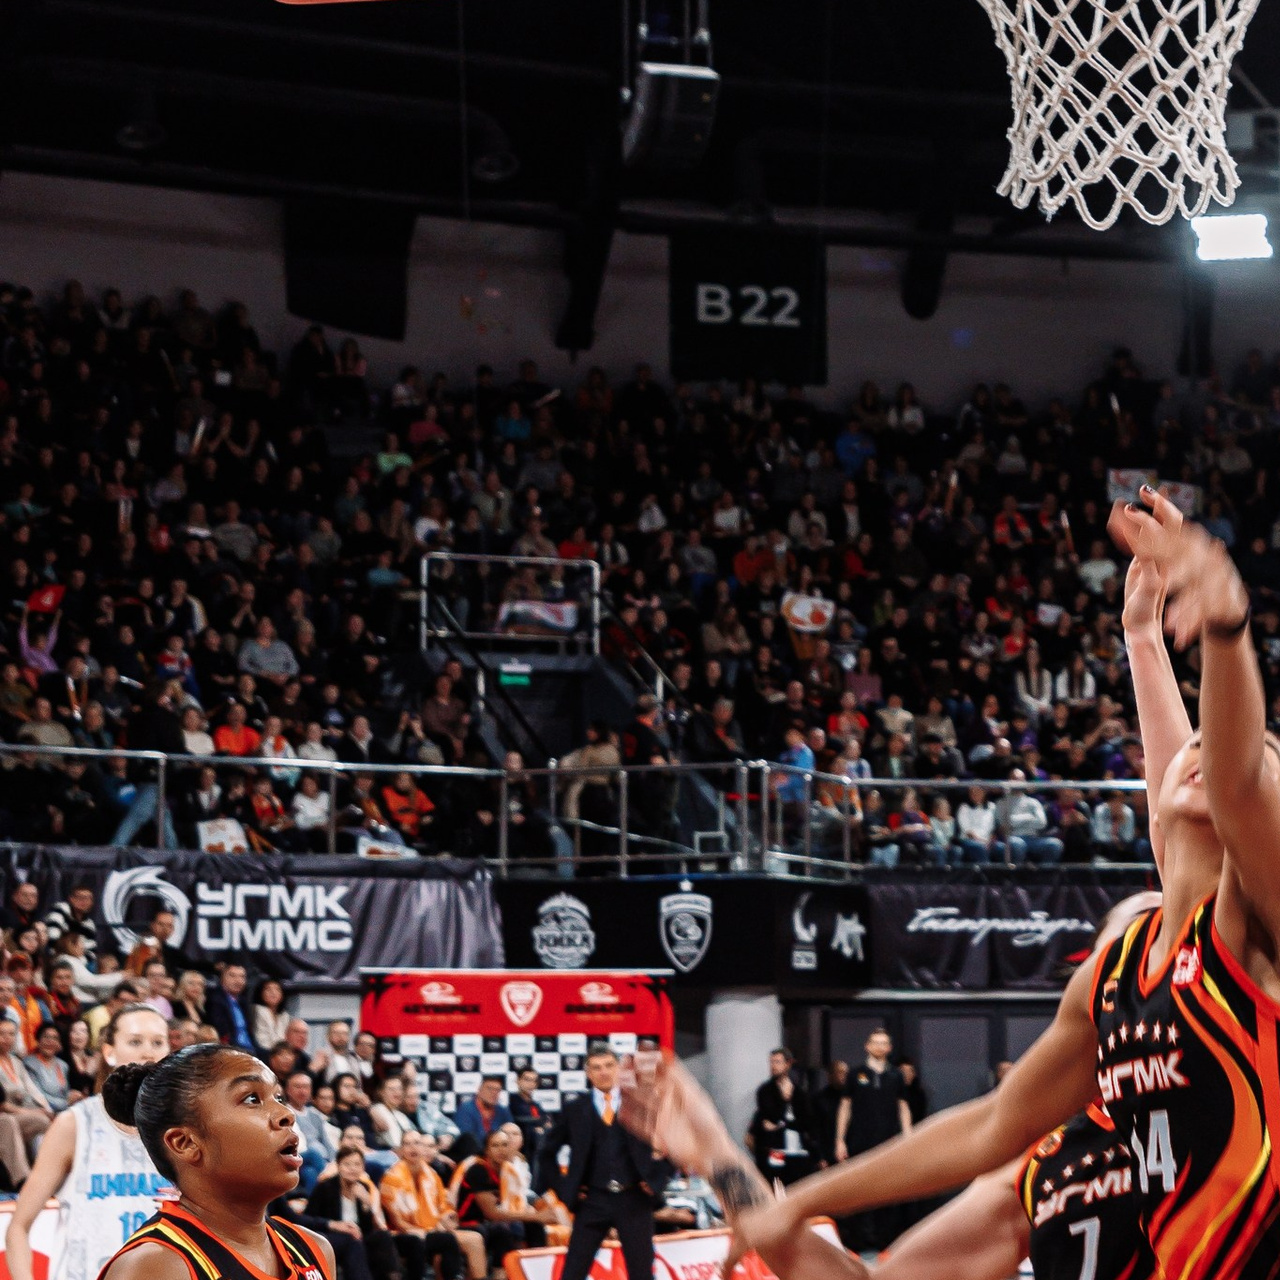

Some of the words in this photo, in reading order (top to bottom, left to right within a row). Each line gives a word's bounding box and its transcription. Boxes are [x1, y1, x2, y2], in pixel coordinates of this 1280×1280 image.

[196, 883, 350, 918] УГМК
[197, 919, 354, 952] UMMC
[1098, 1049, 1190, 1106] УГМК
[1131, 1109, 1178, 1194] 14
